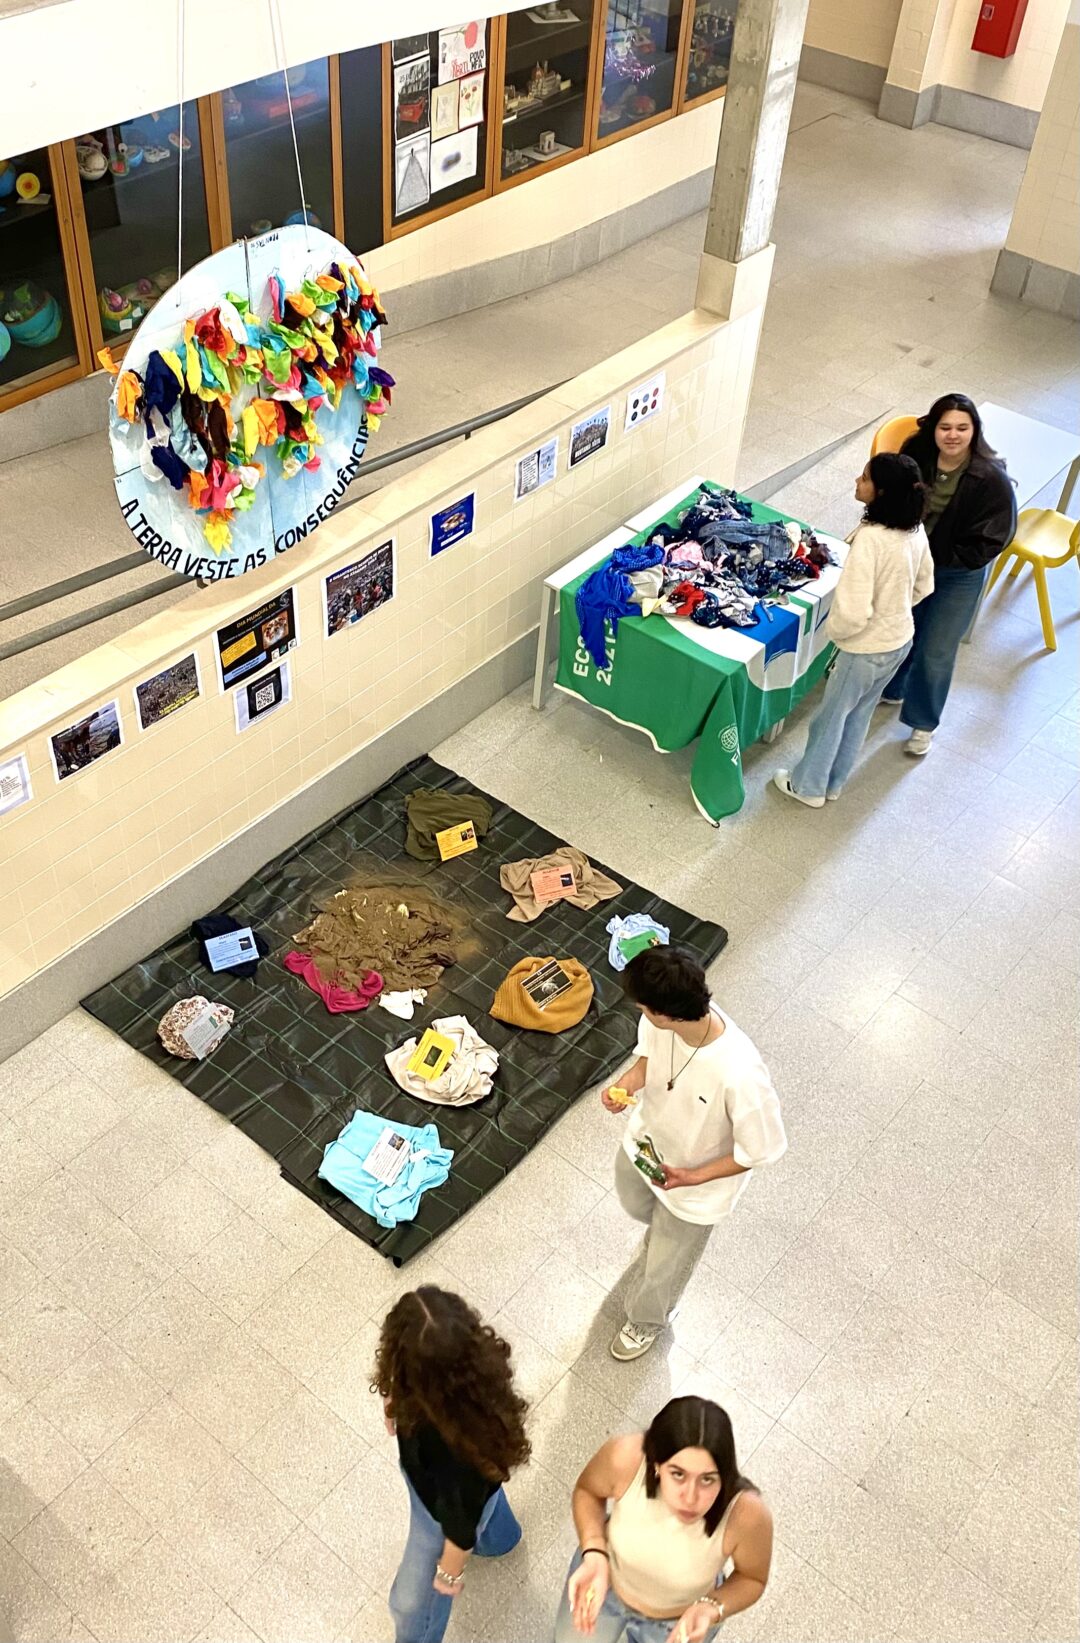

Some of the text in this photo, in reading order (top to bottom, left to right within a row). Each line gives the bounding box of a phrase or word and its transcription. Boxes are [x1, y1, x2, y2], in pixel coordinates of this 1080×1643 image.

[121, 498, 140, 519] A
[130, 513, 183, 570] TERRA
[184, 553, 240, 580] VESTE
[243, 548, 267, 574] AS
